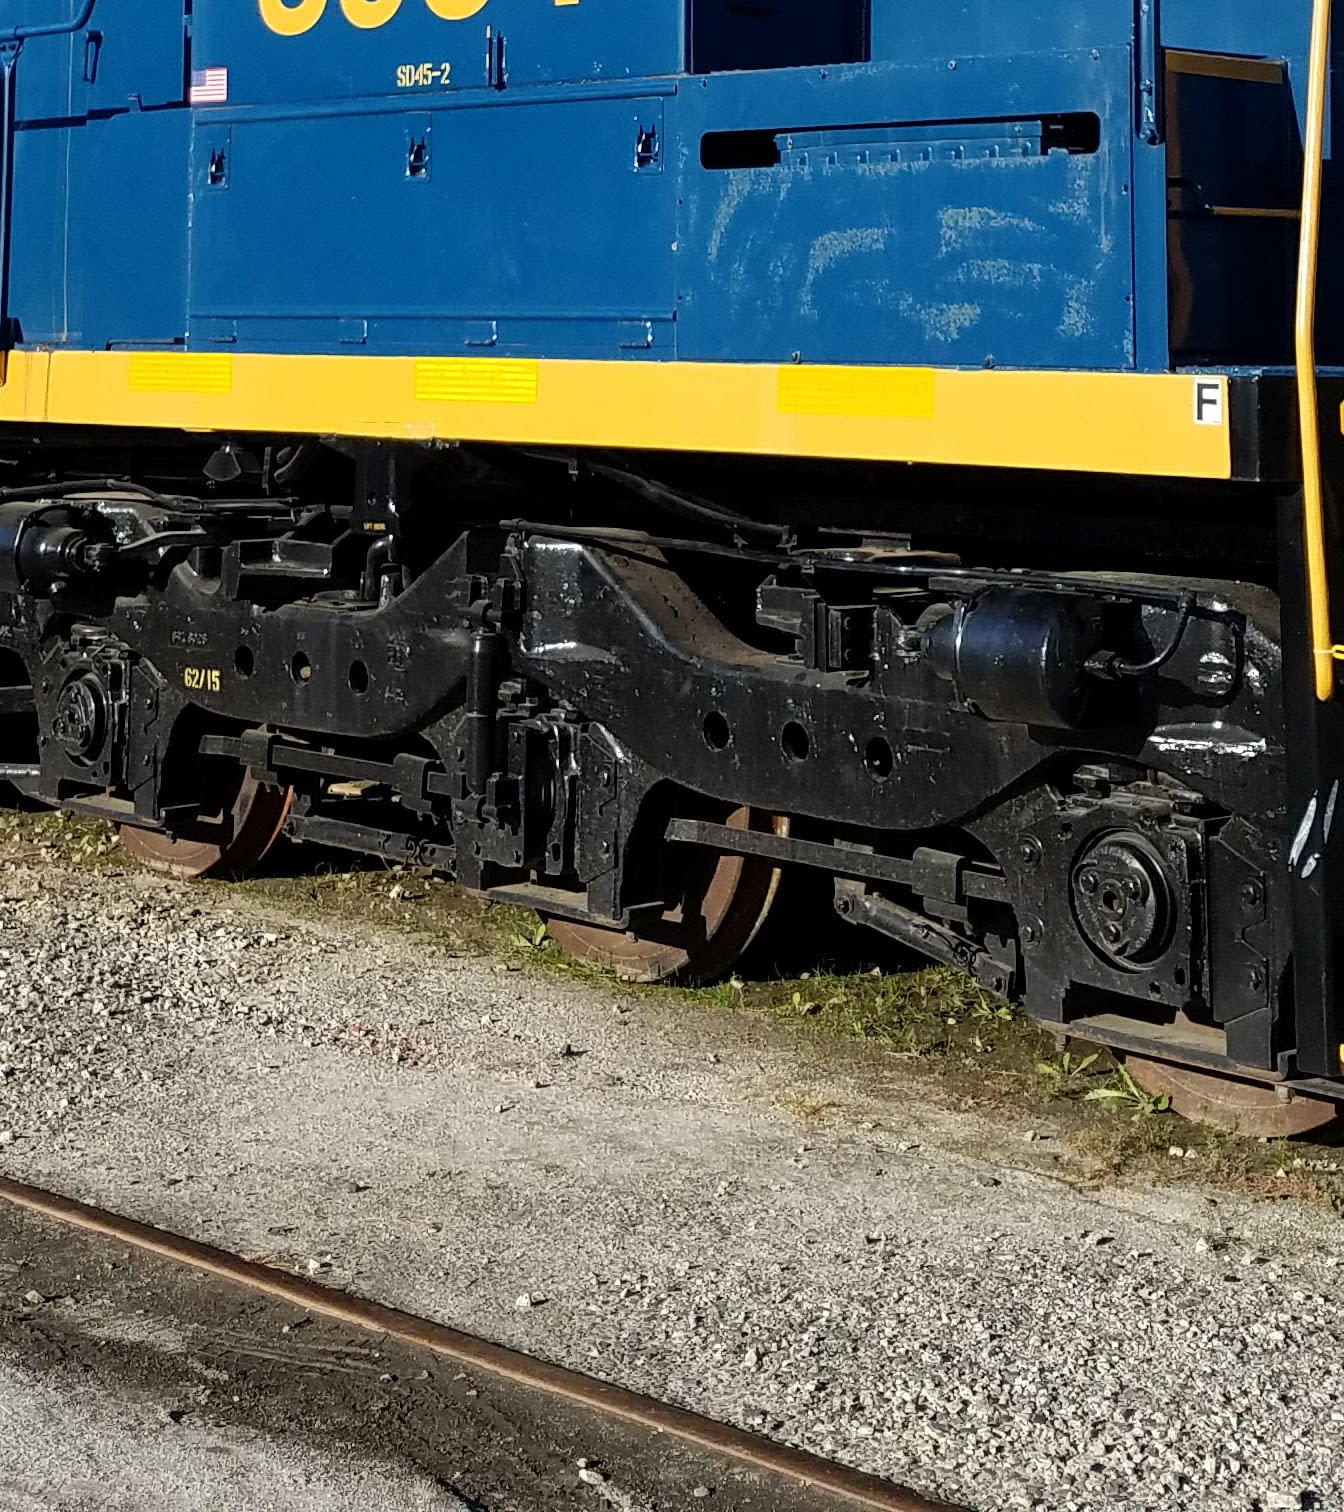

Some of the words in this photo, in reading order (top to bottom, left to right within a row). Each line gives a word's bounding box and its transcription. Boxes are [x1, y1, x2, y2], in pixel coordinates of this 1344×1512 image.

[396, 62, 451, 88] SD45-2
[1197, 382, 1219, 421] F
[184, 667, 221, 692] 62/15
